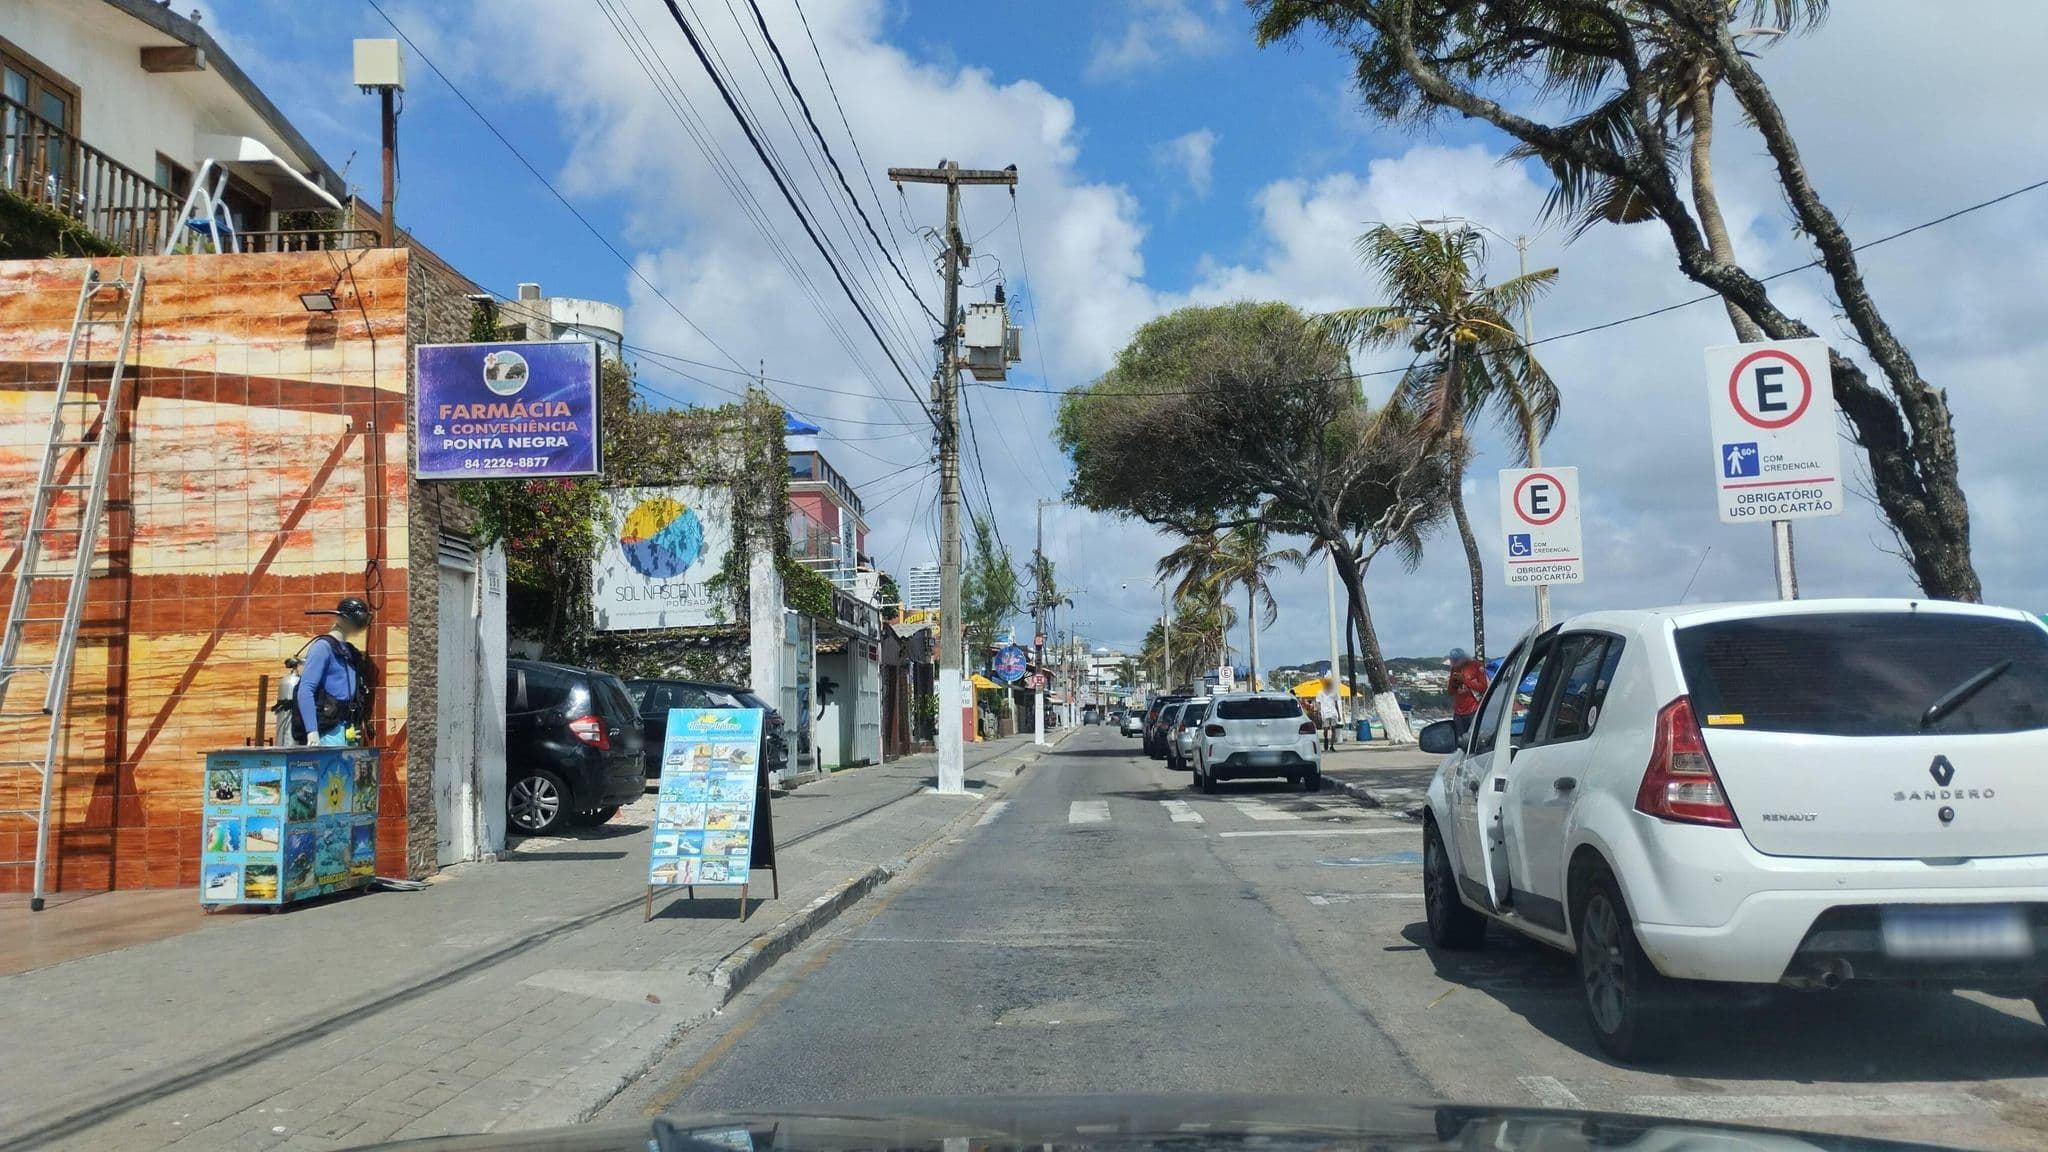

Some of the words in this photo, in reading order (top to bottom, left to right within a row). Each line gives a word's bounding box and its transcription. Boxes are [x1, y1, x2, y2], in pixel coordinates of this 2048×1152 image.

[1755, 366, 1788, 412] E
[439, 398, 572, 420] FARMÁCIA
[433, 424, 446, 435] &
[451, 421, 578, 435] CONVENIÊNCIA
[443, 438, 503, 450] PONTA
[508, 436, 569, 449] NEGRA
[464, 458, 480, 469] 84
[483, 457, 549, 469] 2226-8877
[1763, 454, 1784, 464] COM
[1764, 462, 1820, 472] CREDENCIAL
[1530, 484, 1550, 514] E
[1737, 488, 1823, 504] OBRIGATÓRIO
[1730, 506, 1756, 517] USO
[1760, 504, 1778, 515] DO
[1780, 500, 1833, 513] CARTÃO
[1516, 566, 1571, 574] OBRIGATÓRIO
[1530, 574, 1543, 582] DO
[1544, 572, 1578, 581] CARTÃO
[615, 585, 641, 602] SOL
[1893, 788, 1996, 802] SANDERO
[1762, 812, 1819, 822] RENAULT
